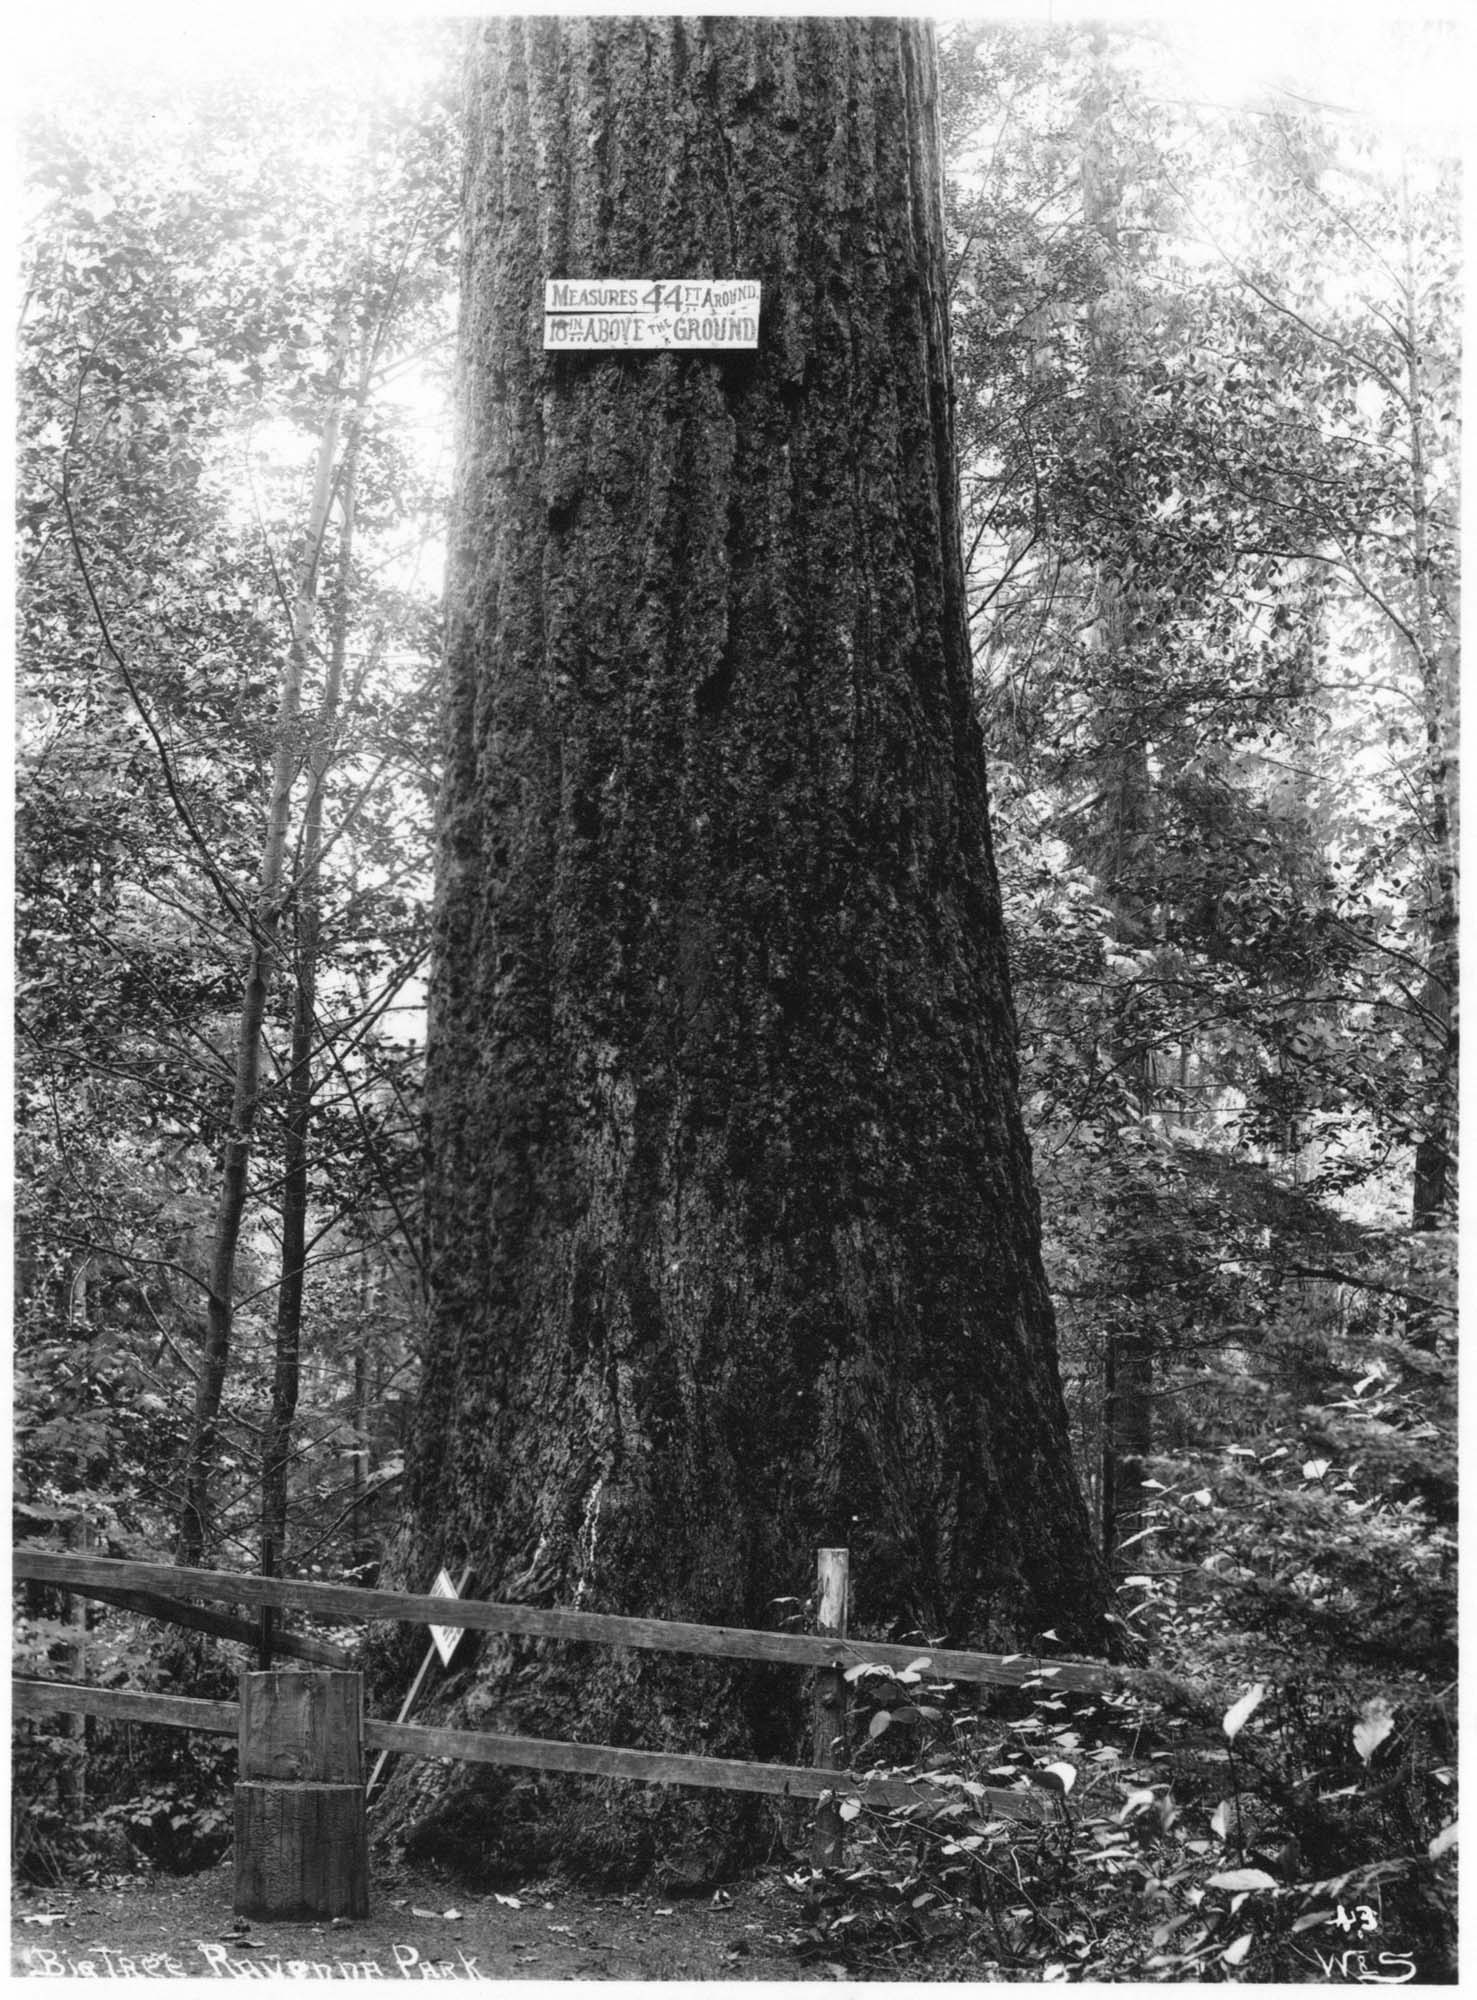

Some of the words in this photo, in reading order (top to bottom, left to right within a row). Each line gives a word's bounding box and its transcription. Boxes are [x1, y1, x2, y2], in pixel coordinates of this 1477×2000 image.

[552, 284, 638, 307] MEASURES
[641, 284, 683, 313] 44
[584, 317, 643, 343] ABOVE
[648, 318, 672, 335] THE
[674, 317, 757, 341] GROUND
